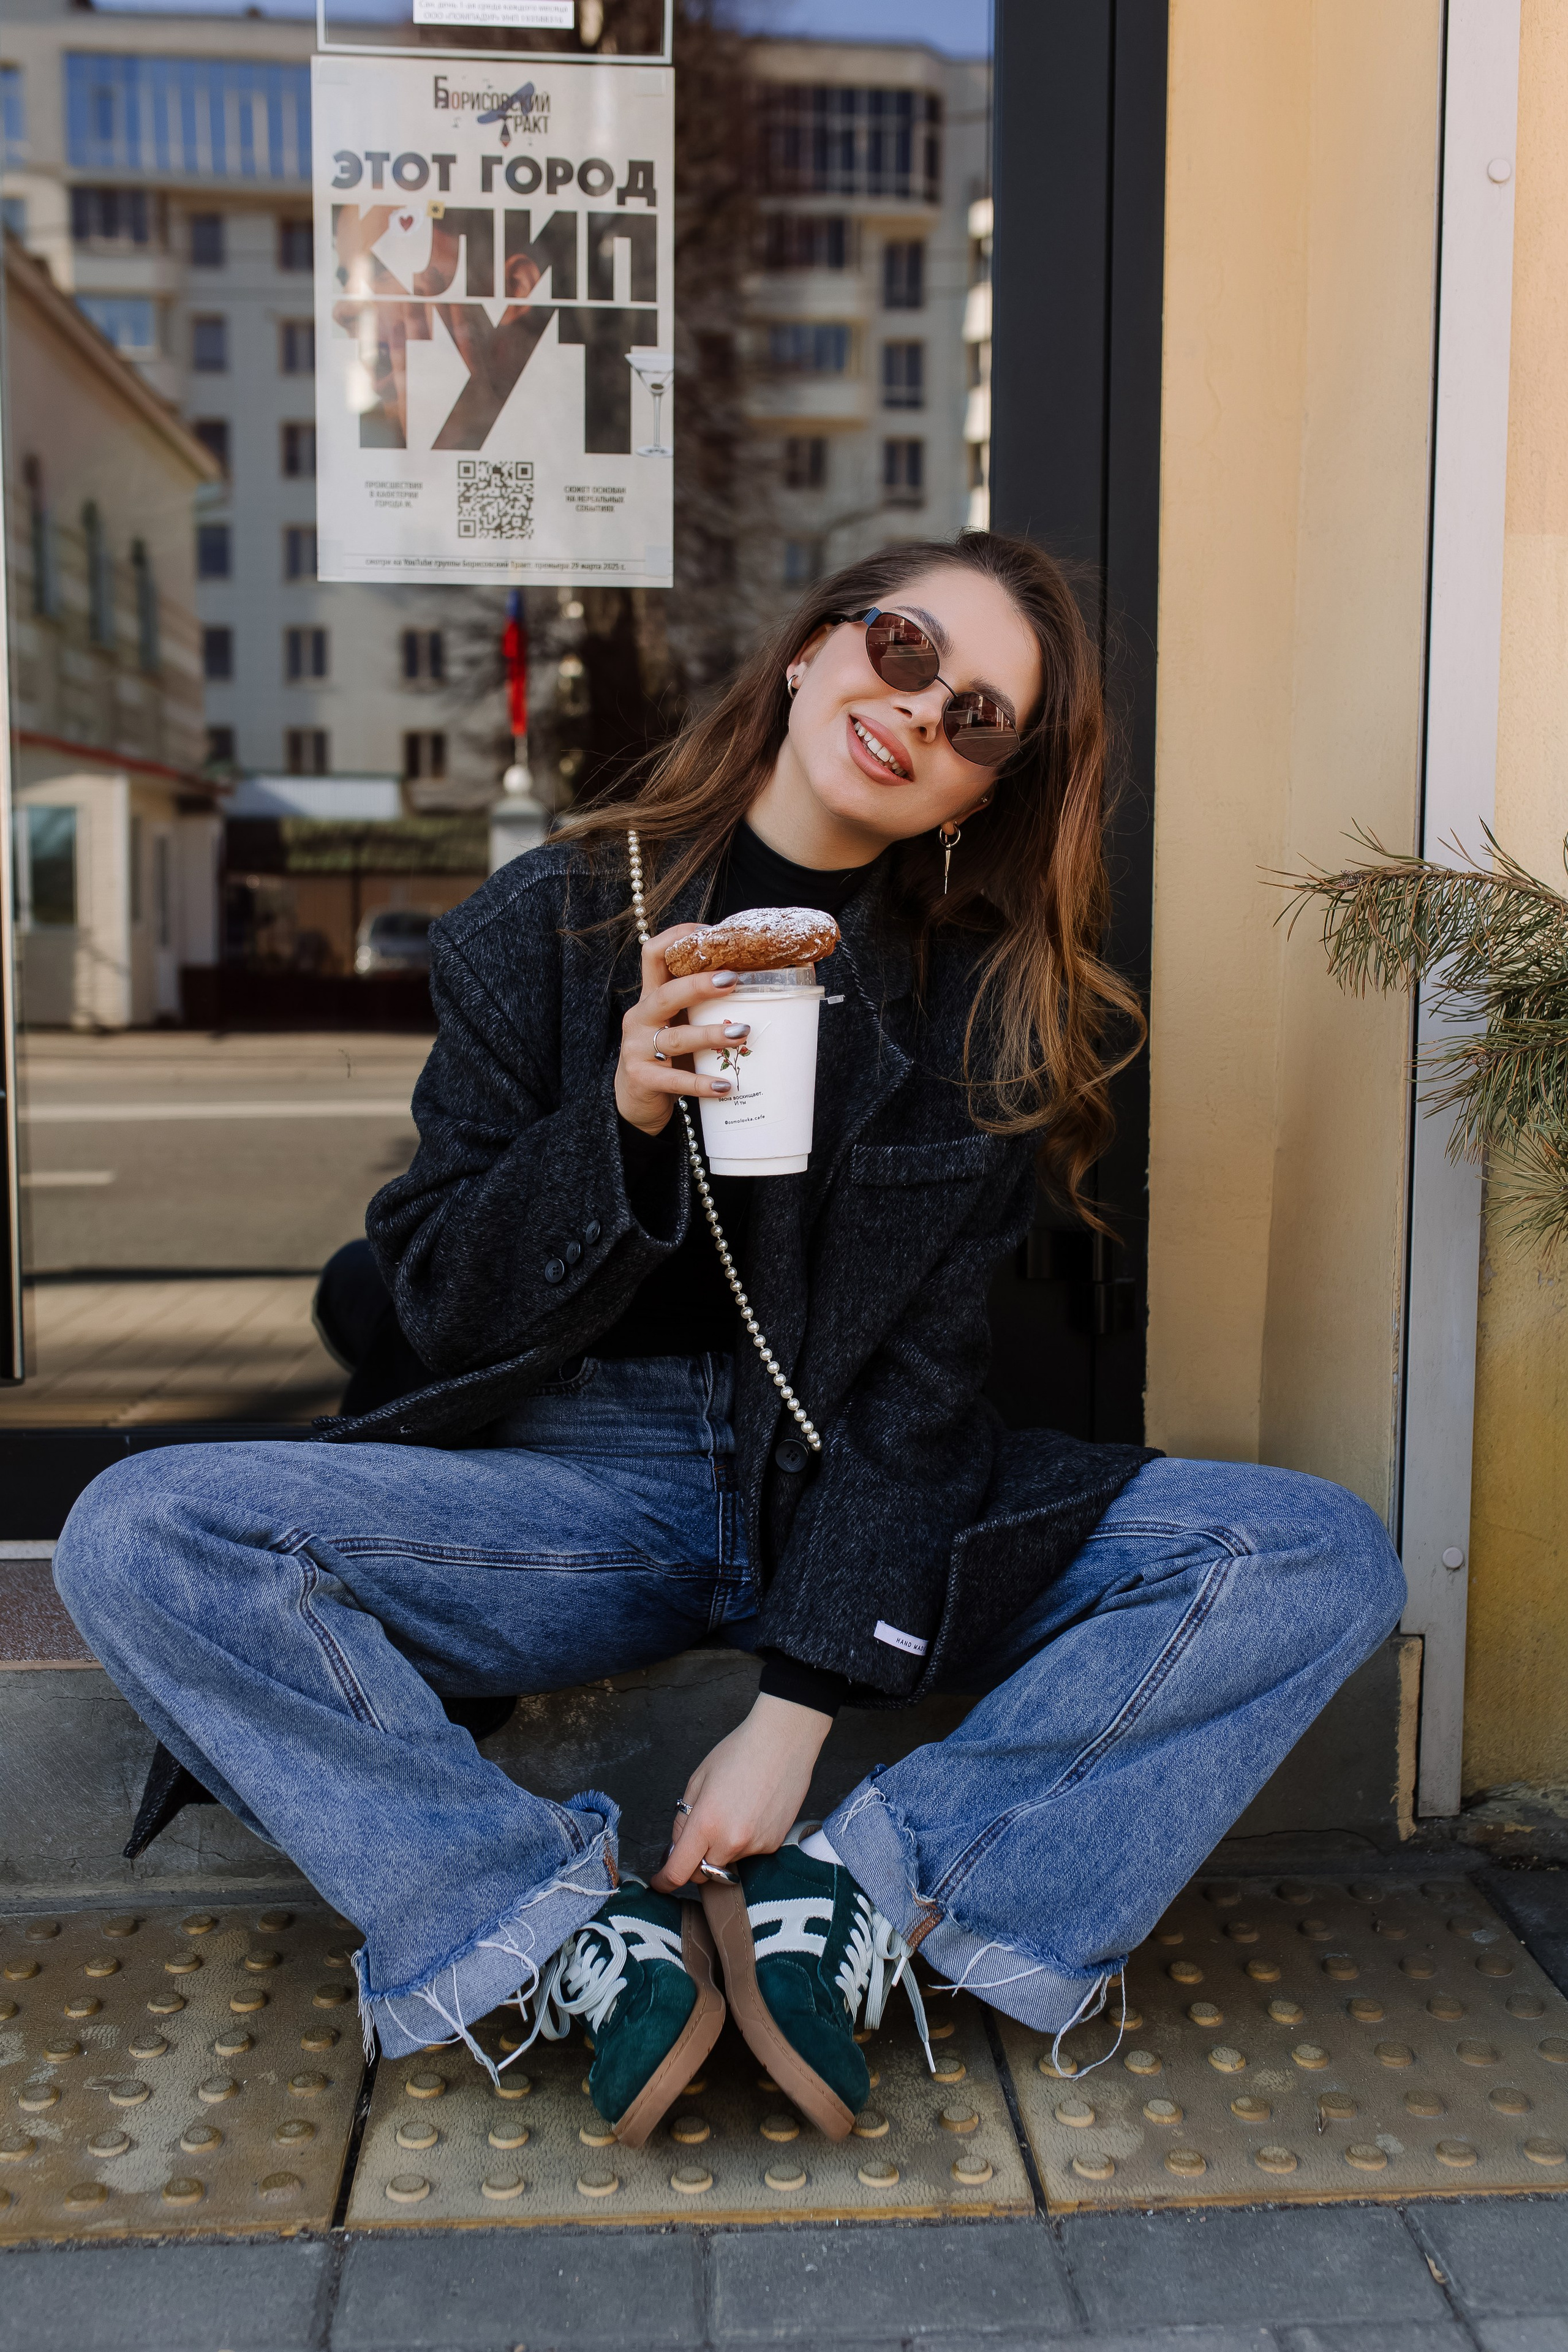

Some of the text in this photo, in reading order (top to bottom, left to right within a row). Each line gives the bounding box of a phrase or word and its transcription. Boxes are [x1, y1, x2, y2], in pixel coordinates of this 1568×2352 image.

[331, 150, 657, 207] ЭТОТ ГОРОД
[331, 203, 658, 302] КЛИП
[332, 302, 659, 454] ТУТ
[733, 1091, 763, 1100] восхищает.
[725, 1114, 765, 1125] @osmolovka.cafe
[896, 1637, 912, 1648] HAND
